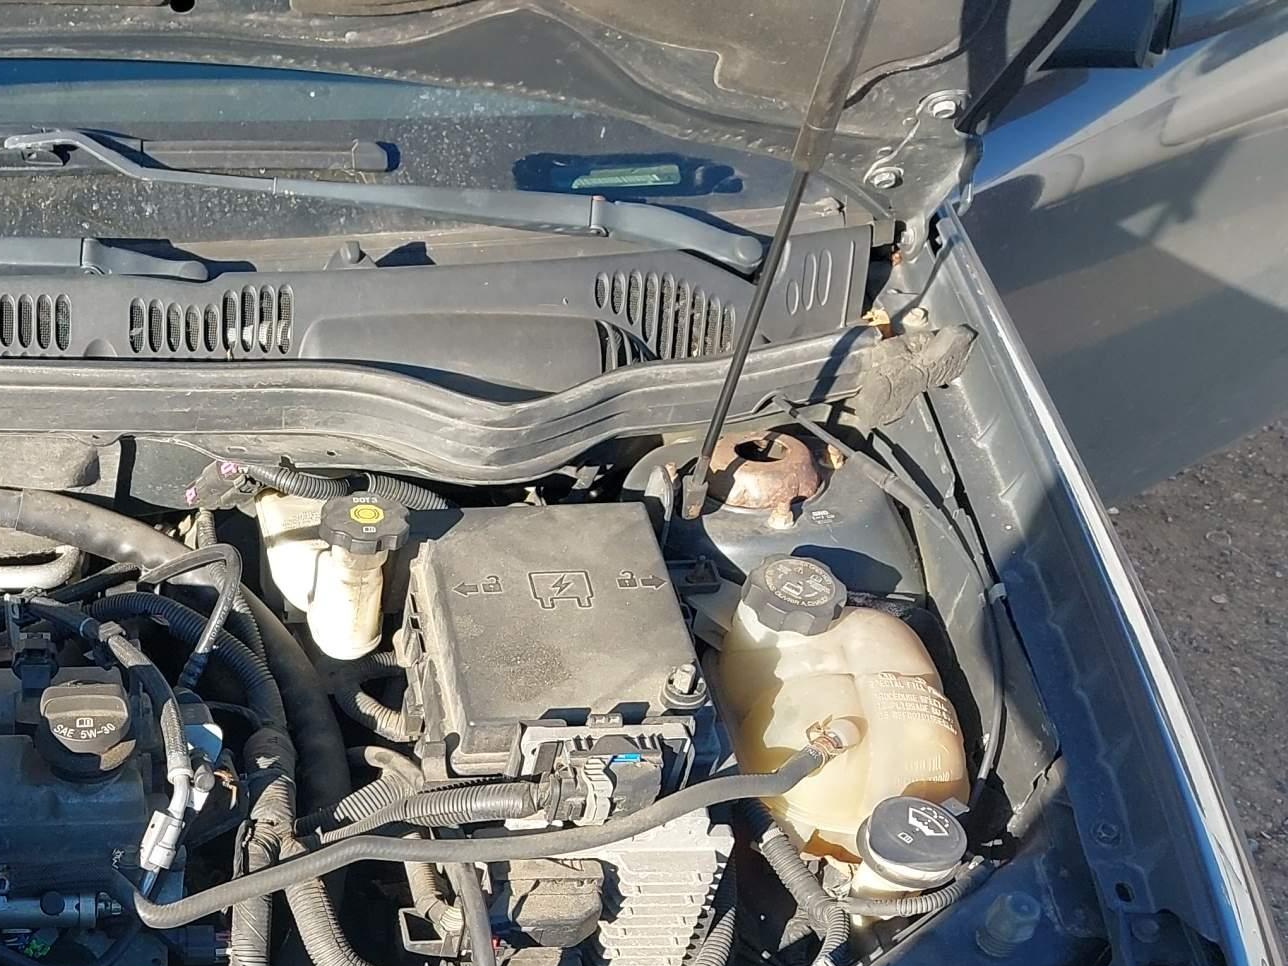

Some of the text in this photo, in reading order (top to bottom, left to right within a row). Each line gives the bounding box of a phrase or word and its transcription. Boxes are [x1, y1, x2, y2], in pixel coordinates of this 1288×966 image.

[352, 496, 378, 504] DOT 3
[53, 722, 117, 739] SAE 5W-30
